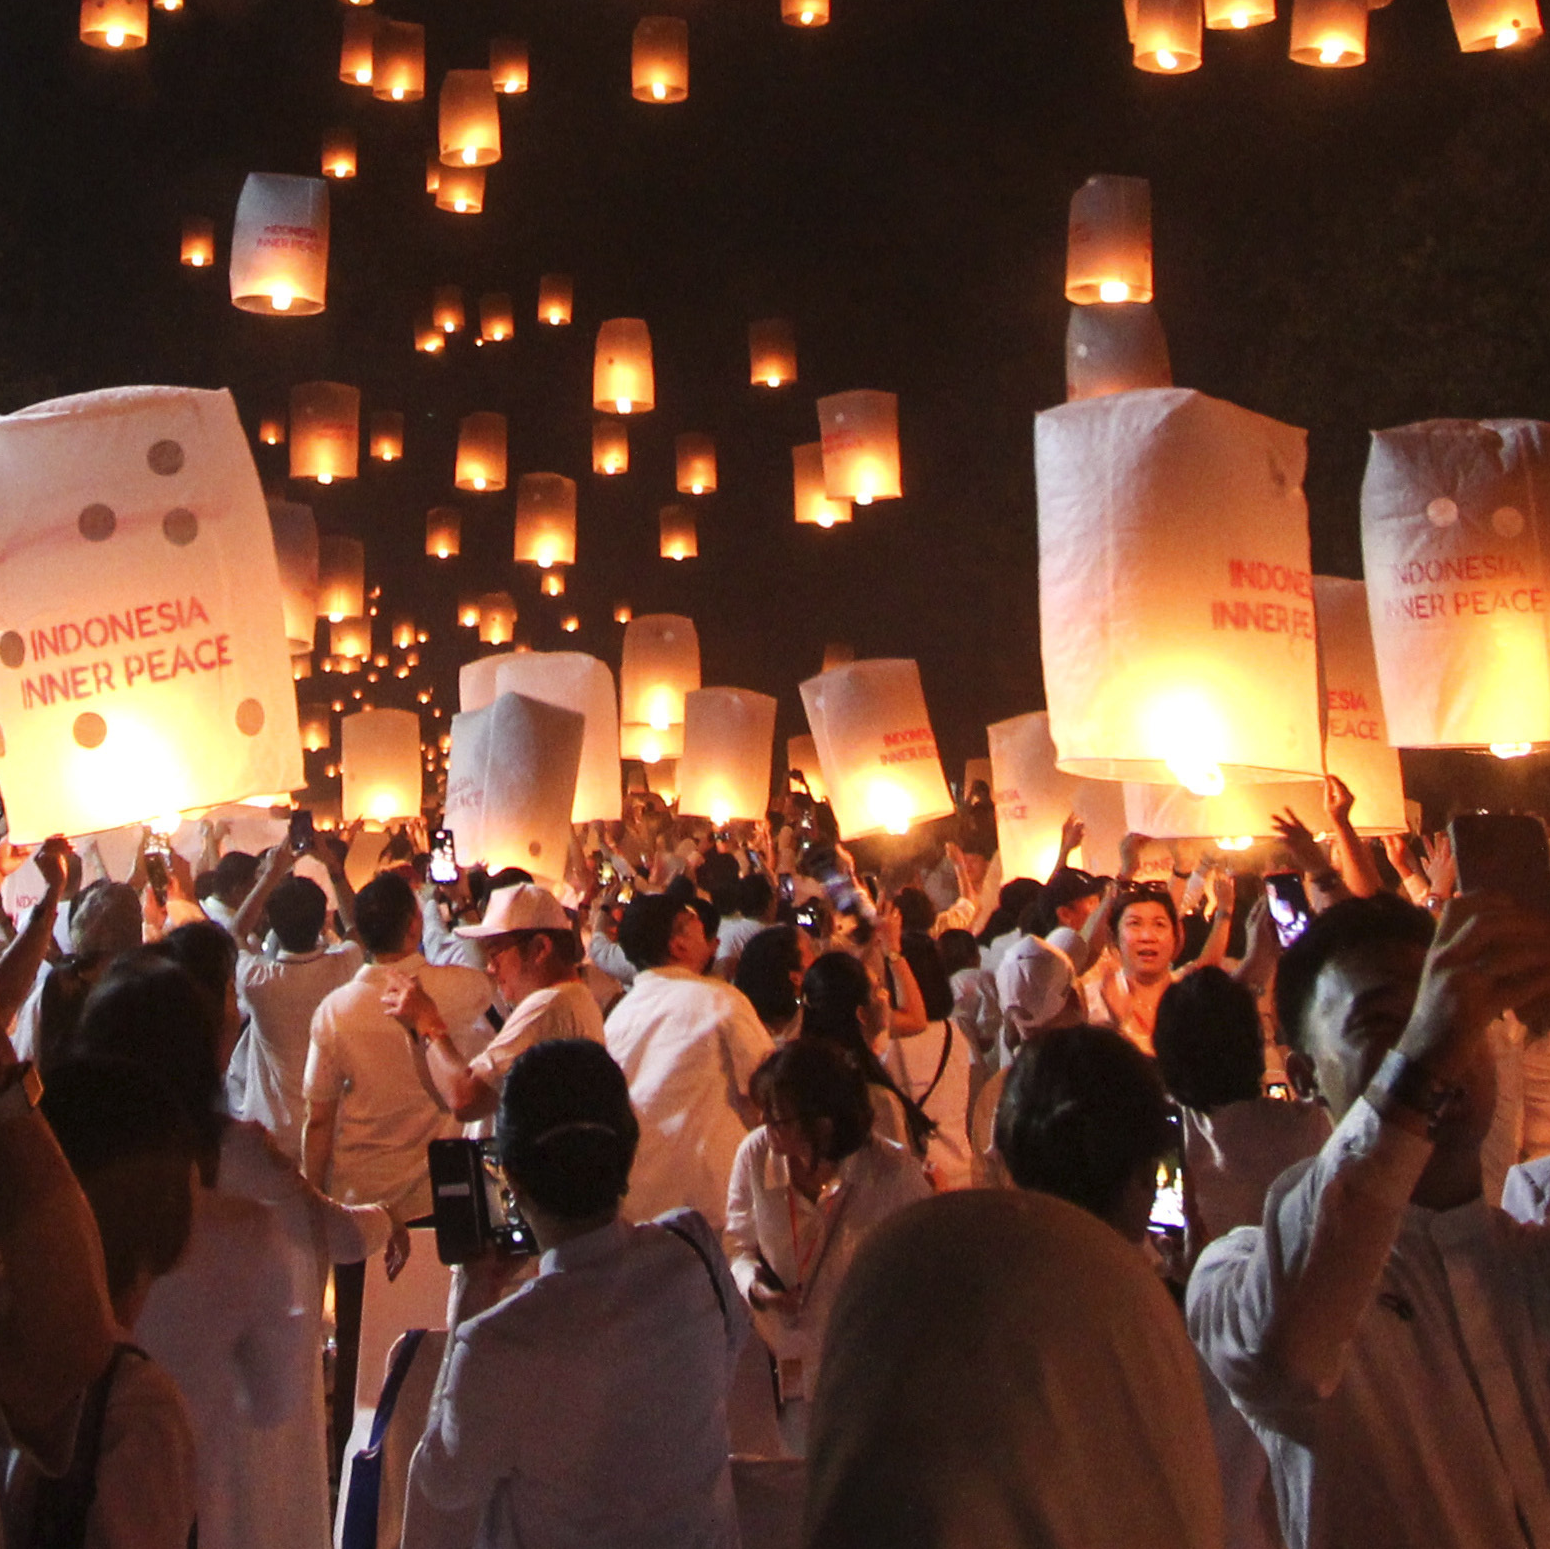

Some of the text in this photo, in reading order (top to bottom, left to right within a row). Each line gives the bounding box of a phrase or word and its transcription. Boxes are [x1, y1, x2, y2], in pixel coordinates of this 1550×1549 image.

[1211, 601, 1289, 633] INNER
[1453, 588, 1547, 617] PEACE
[30, 596, 211, 662] INDONESIA
[21, 633, 234, 710] INNER PEACE
